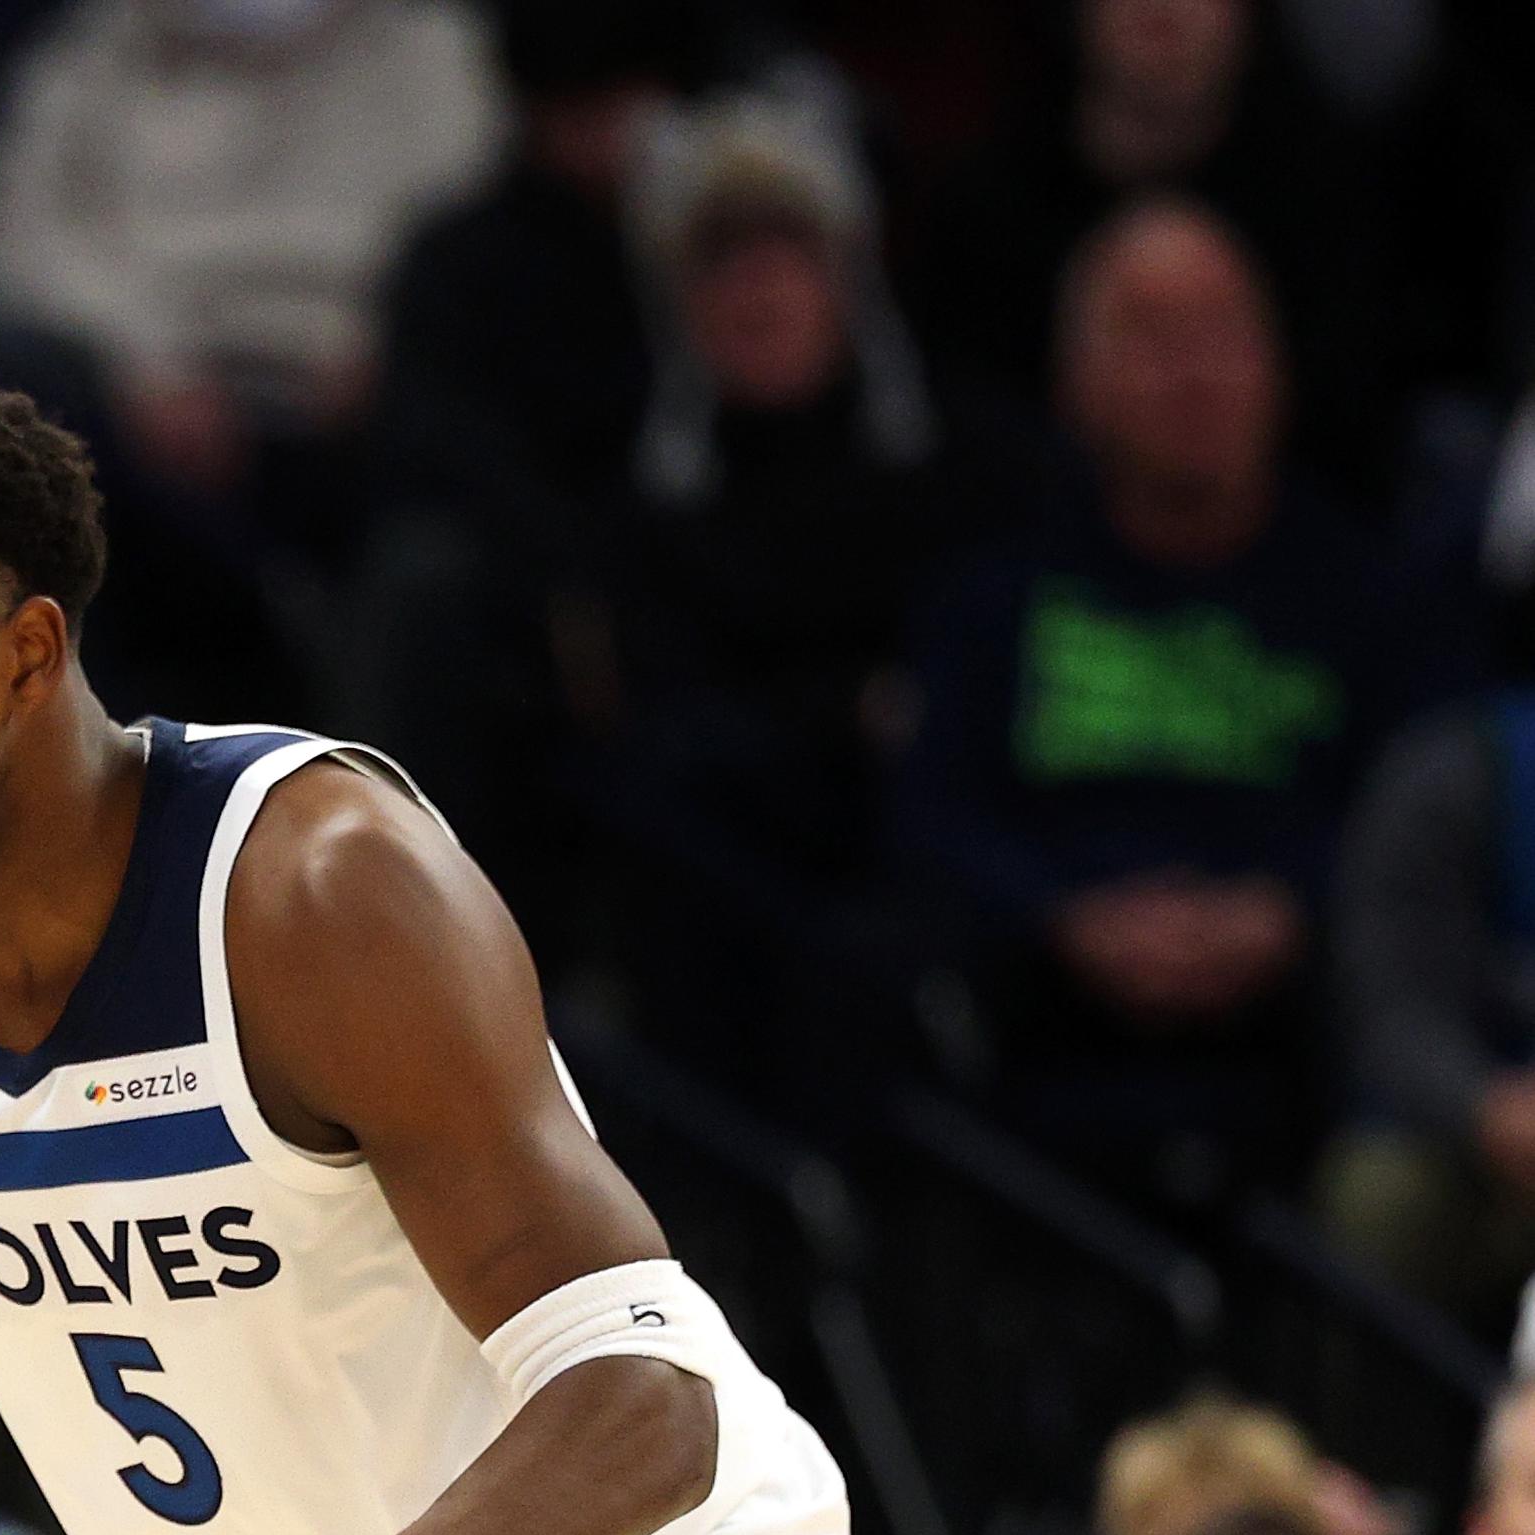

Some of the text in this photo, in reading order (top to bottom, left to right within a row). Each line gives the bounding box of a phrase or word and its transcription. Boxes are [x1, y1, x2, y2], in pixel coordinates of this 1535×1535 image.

[109, 1065, 198, 1102] sezzle
[629, 1301, 667, 1328] 5
[69, 1332, 224, 1526] 5
